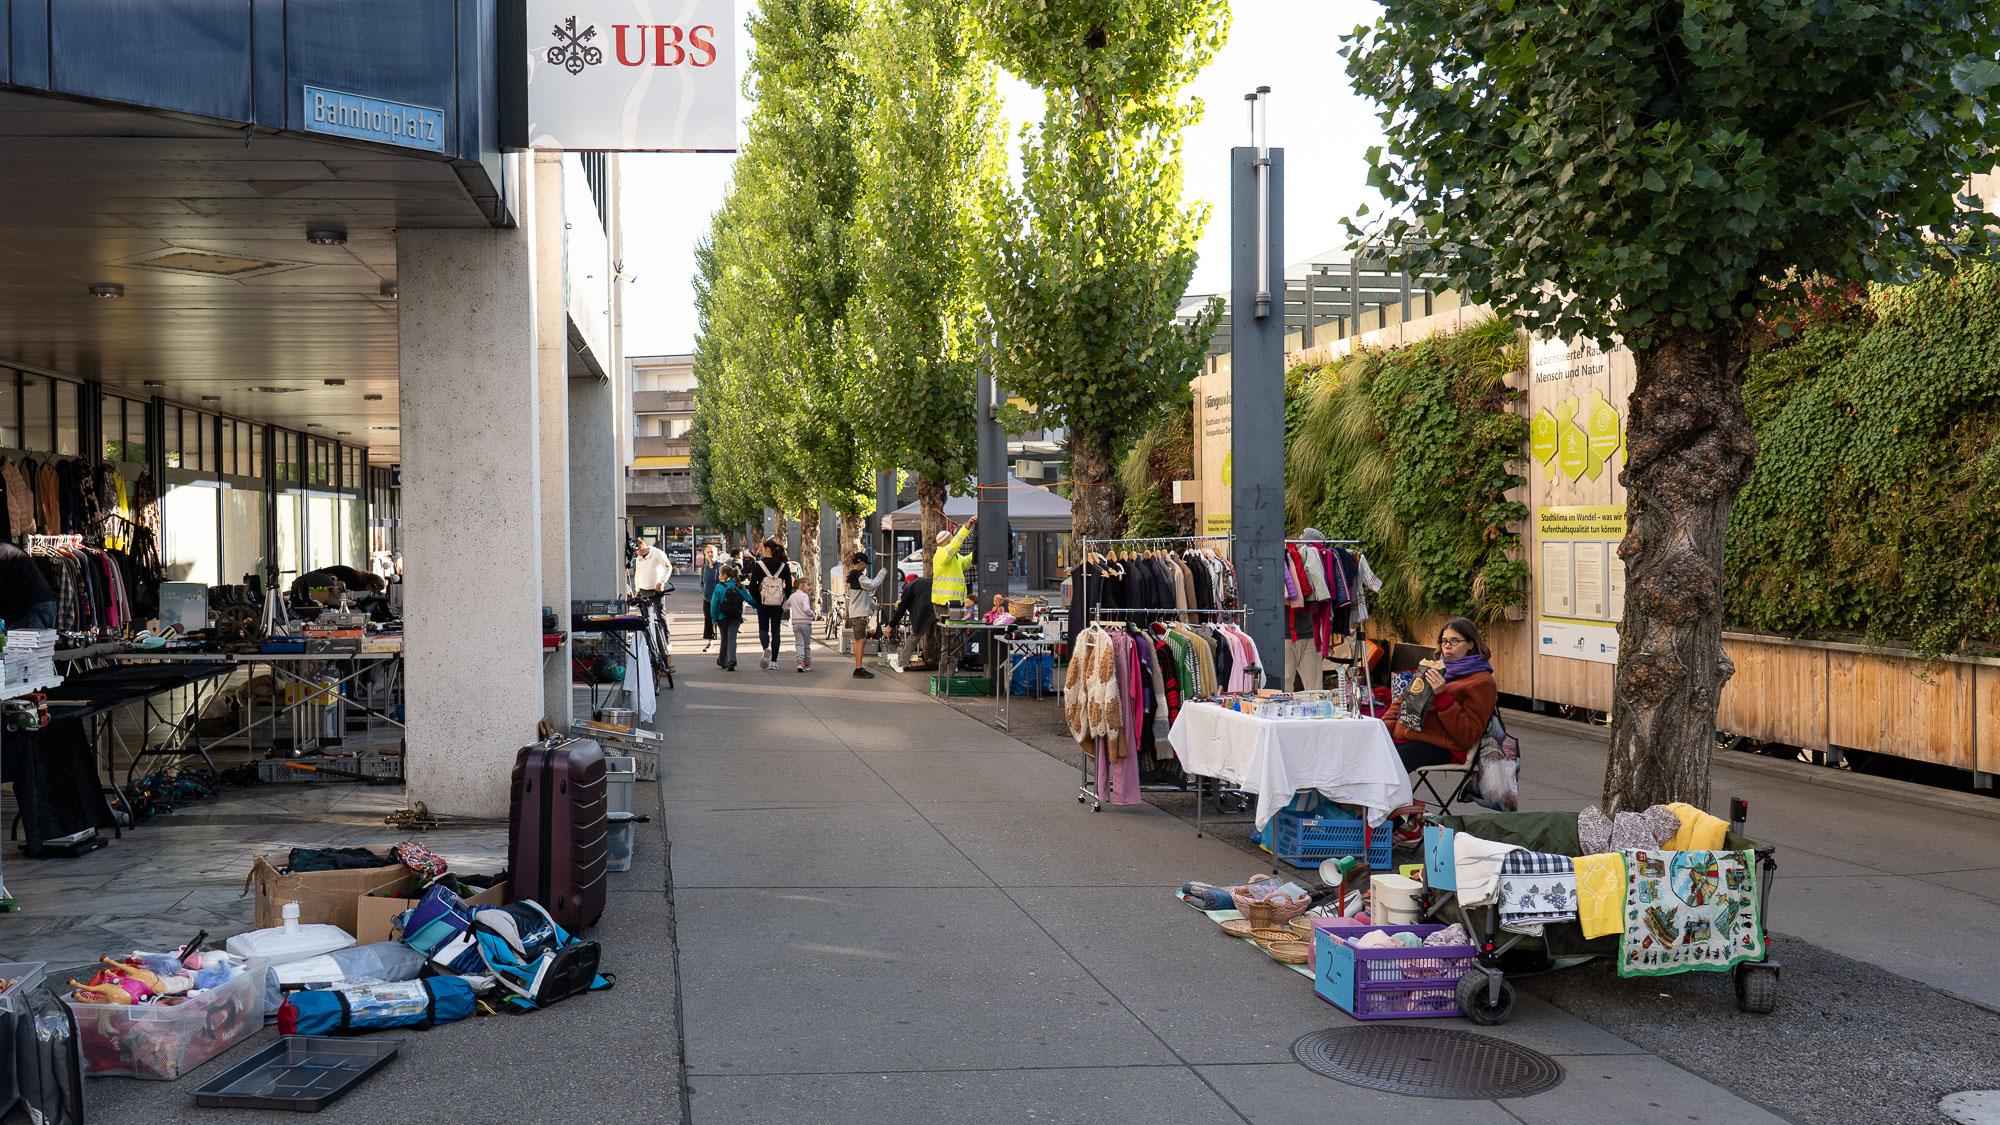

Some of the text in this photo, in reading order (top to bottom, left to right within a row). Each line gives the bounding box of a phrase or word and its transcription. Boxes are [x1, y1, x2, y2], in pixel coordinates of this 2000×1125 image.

[611, 25, 716, 66] UBS
[314, 93, 436, 141] Bahnhofplatz
[1535, 348, 1584, 366] Lebenswerter
[1586, 344, 1609, 358] Rau
[1535, 364, 1604, 383] Mensch und Natur
[1541, 512, 1568, 522] Stadtklima
[1568, 513, 1576, 521] im
[1577, 512, 1597, 521] Wandel
[1613, 512, 1623, 521] wir
[1542, 525, 1622, 535] Aufenthaltsqualität tun können
